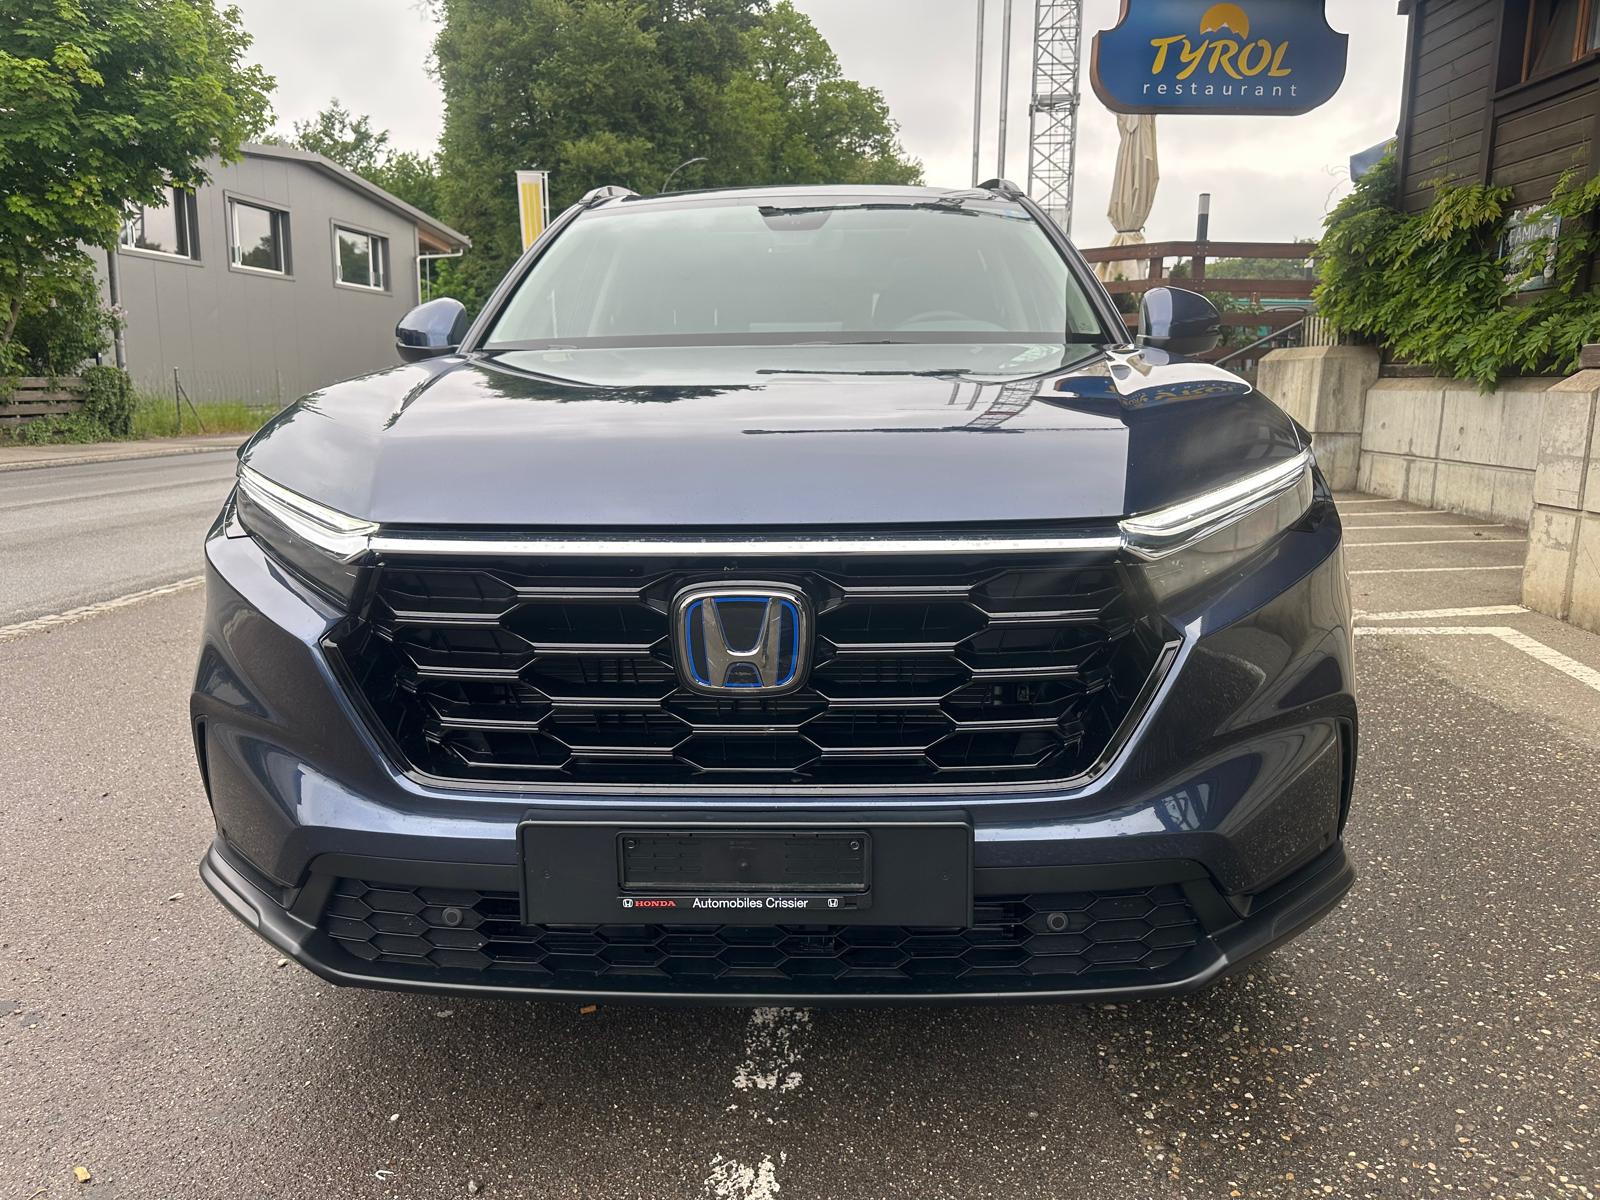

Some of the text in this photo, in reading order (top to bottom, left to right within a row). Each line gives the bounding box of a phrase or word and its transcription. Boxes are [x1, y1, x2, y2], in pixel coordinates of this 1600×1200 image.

[1151, 34, 1291, 79] TYROL
[1143, 83, 1297, 96] restaurant
[692, 898, 762, 909] Automobiles
[765, 898, 808, 909] Crissier
